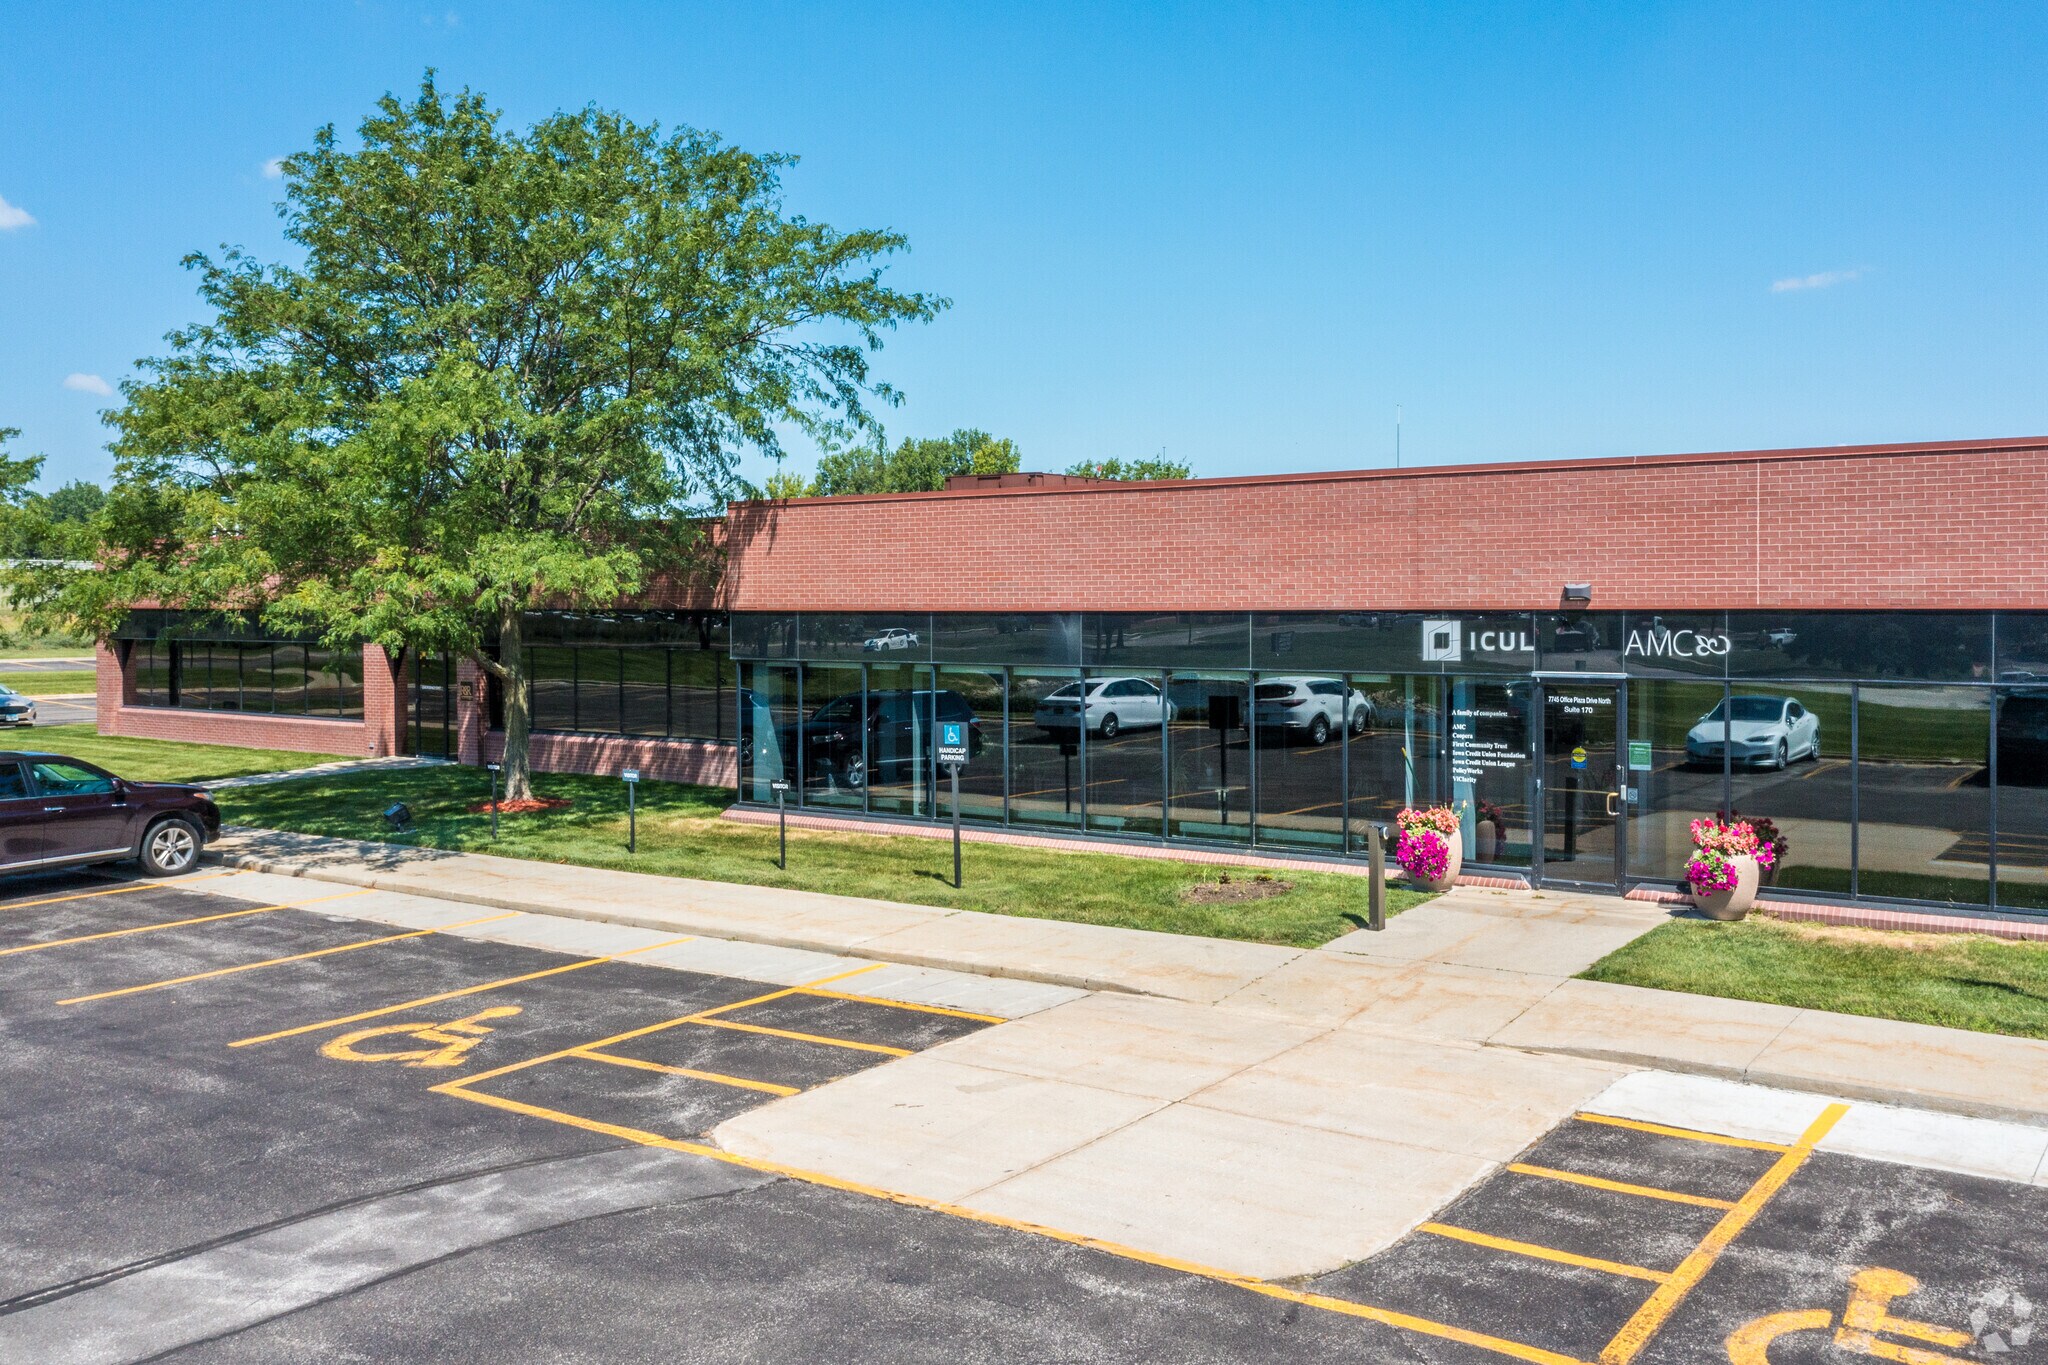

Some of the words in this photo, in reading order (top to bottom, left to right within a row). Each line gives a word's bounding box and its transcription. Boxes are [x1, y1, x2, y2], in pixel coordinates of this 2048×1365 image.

[1470, 631, 1535, 651] ICUL
[1624, 630, 1693, 657] AMC
[1573, 696, 1585, 704] Plaza
[1457, 709, 1473, 717] family
[1581, 706, 1593, 714] 170
[1465, 741, 1494, 750] Community
[1497, 751, 1526, 759] Foundation
[1497, 760, 1516, 768] League
